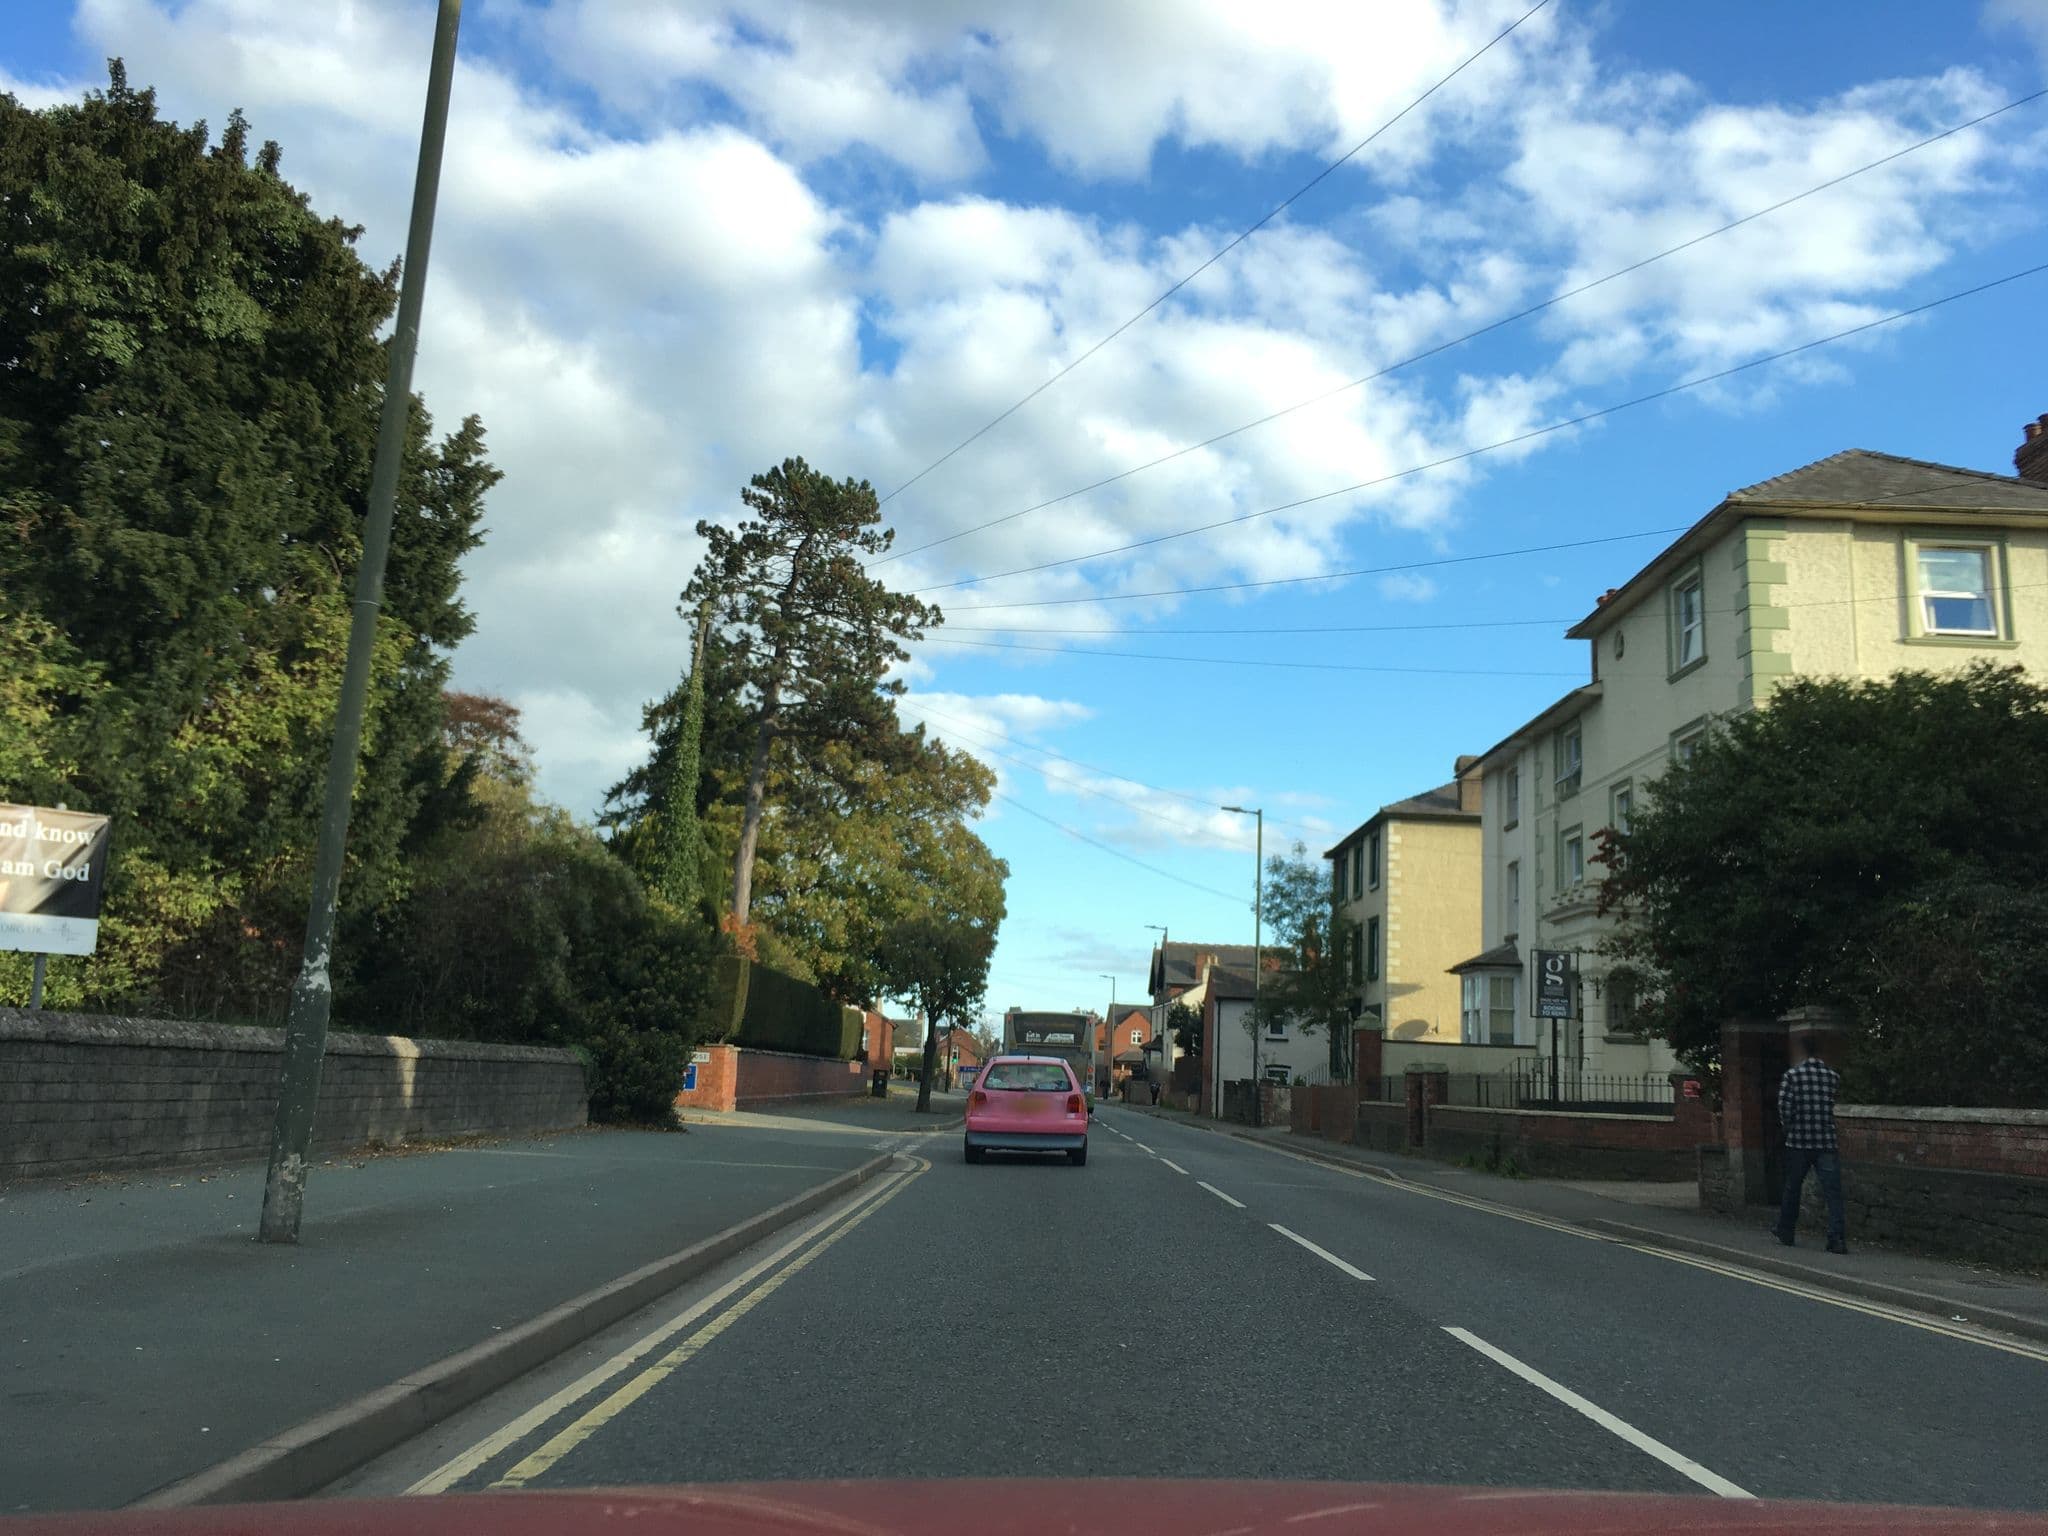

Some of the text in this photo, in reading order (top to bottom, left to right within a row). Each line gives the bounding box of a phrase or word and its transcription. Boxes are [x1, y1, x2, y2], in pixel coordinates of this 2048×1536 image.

[35, 821, 95, 844] know
[1, 860, 90, 881] am God
